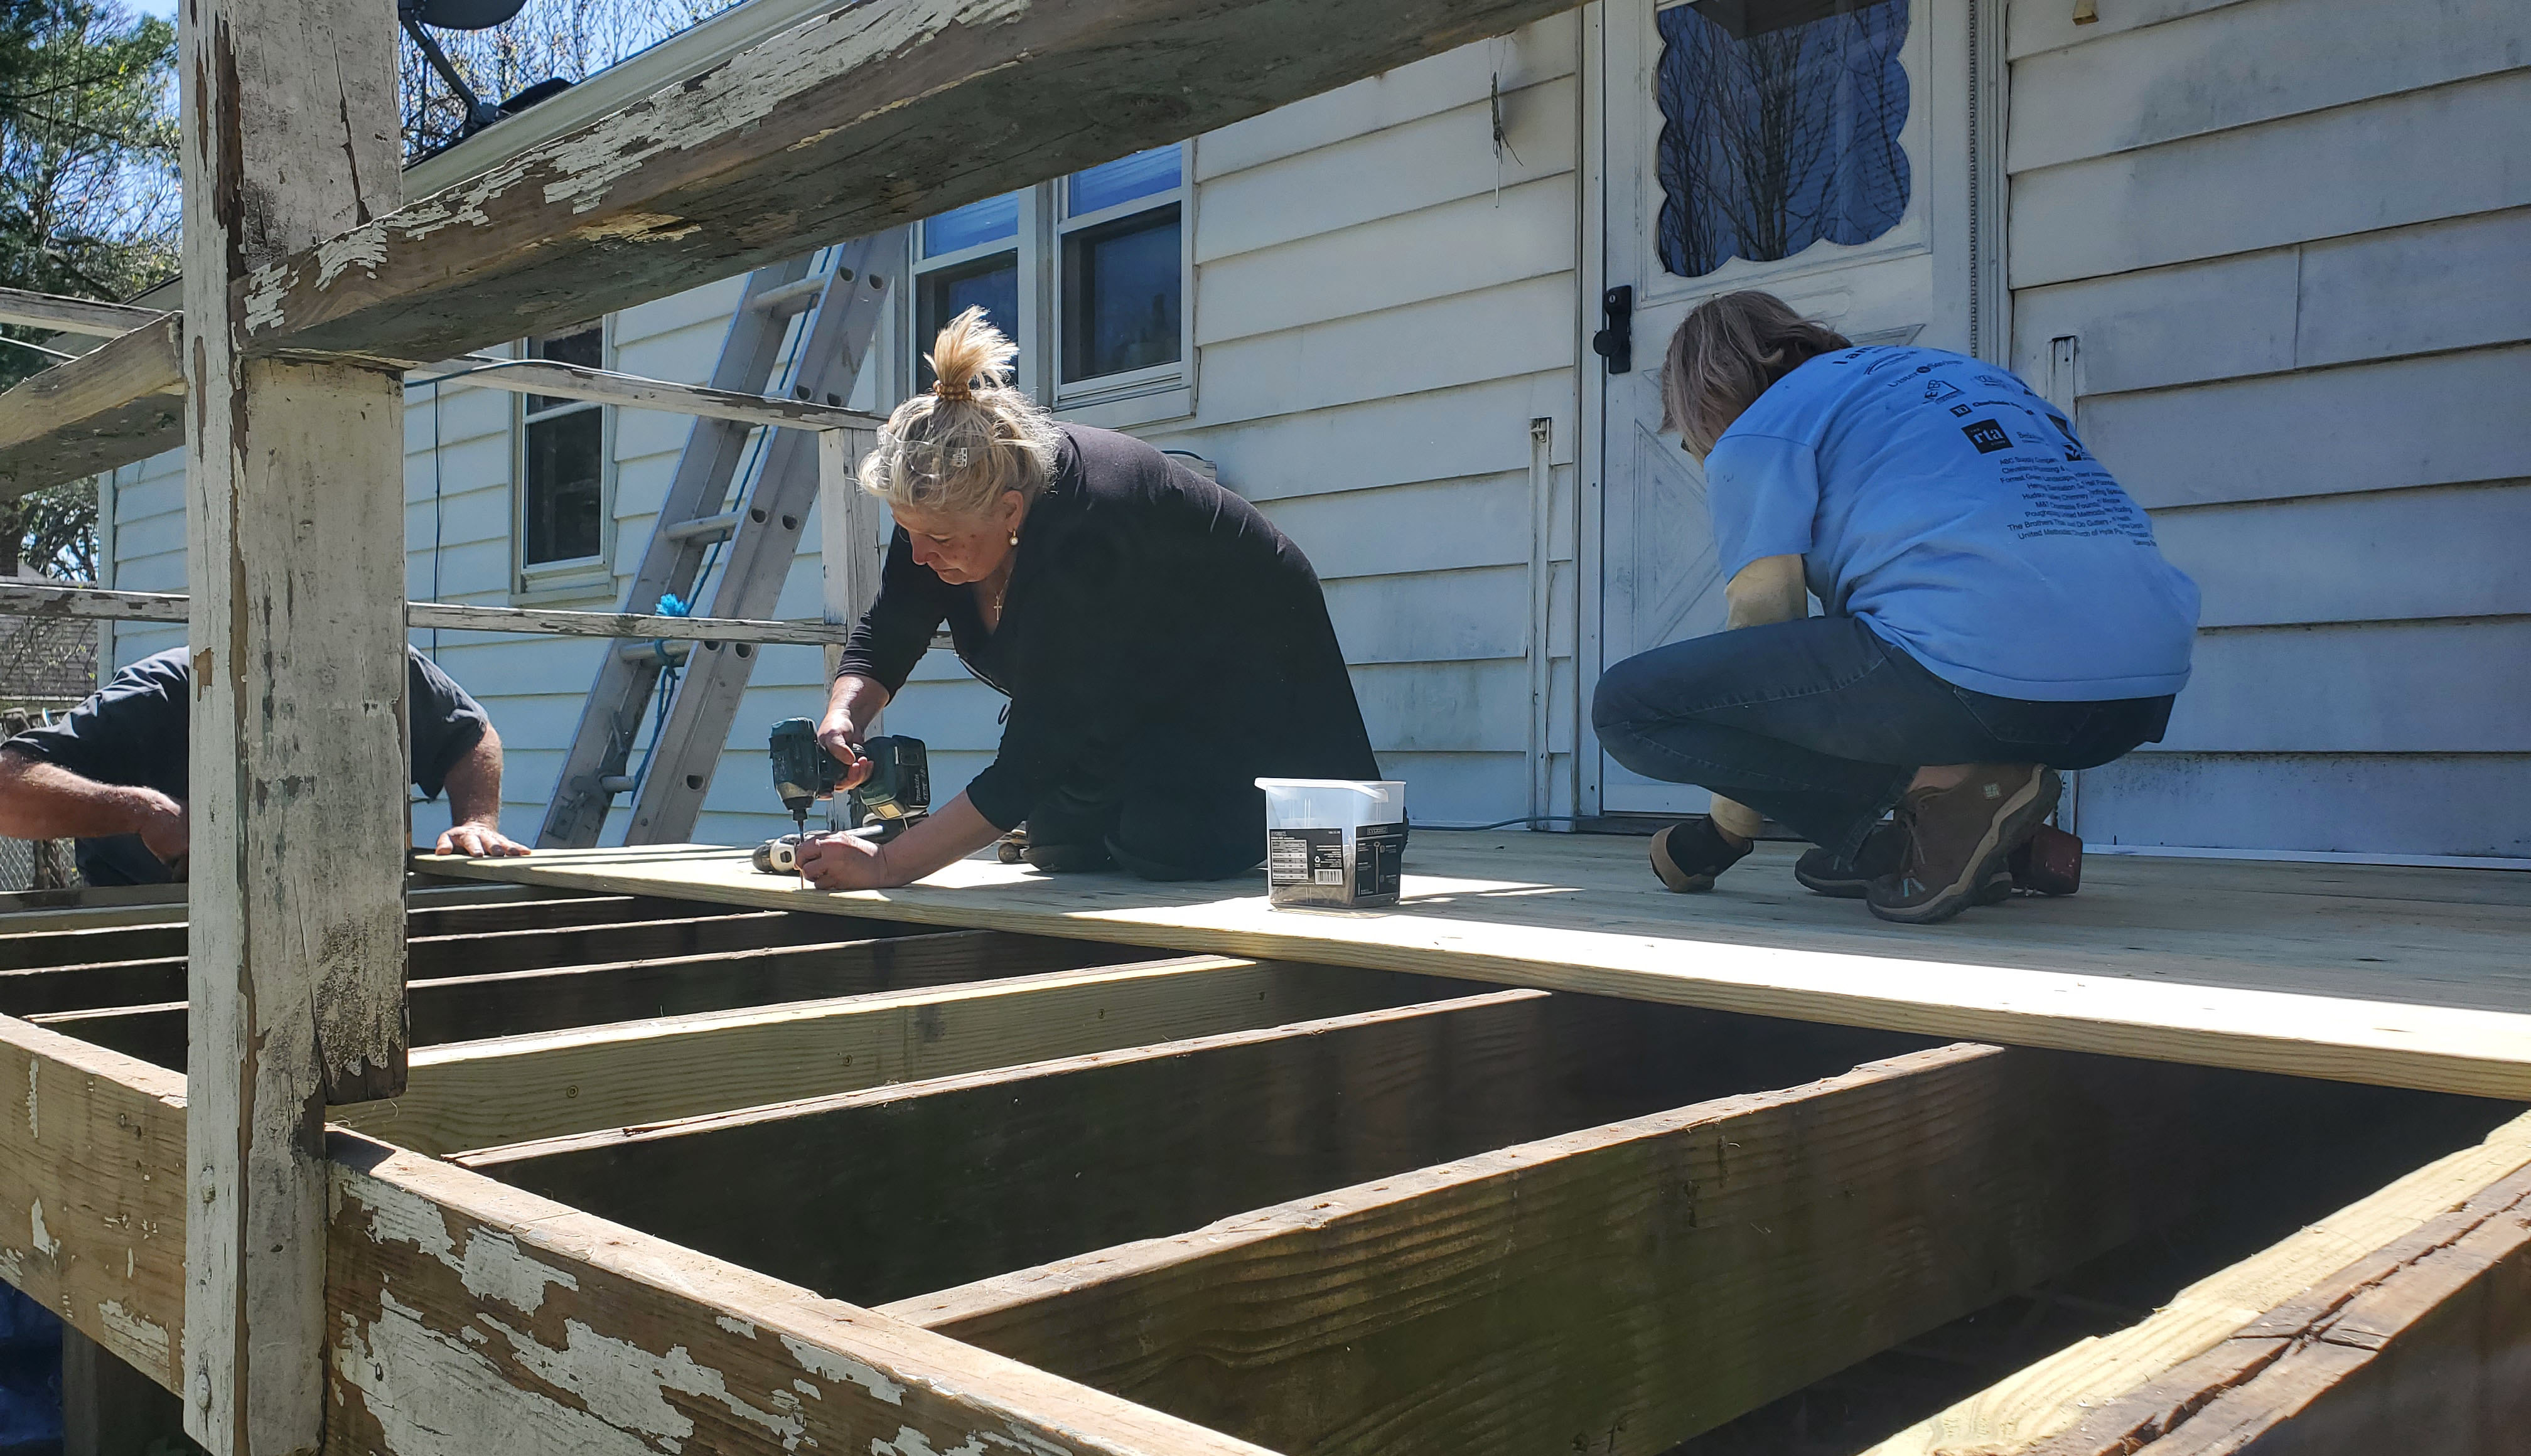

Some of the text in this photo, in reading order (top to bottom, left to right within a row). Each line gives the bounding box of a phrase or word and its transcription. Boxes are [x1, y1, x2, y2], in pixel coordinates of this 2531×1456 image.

[1972, 429, 2004, 444] rta
[2007, 523, 2023, 532] The
[2024, 520, 2053, 528] Brothers
[2018, 530, 2043, 540] United
